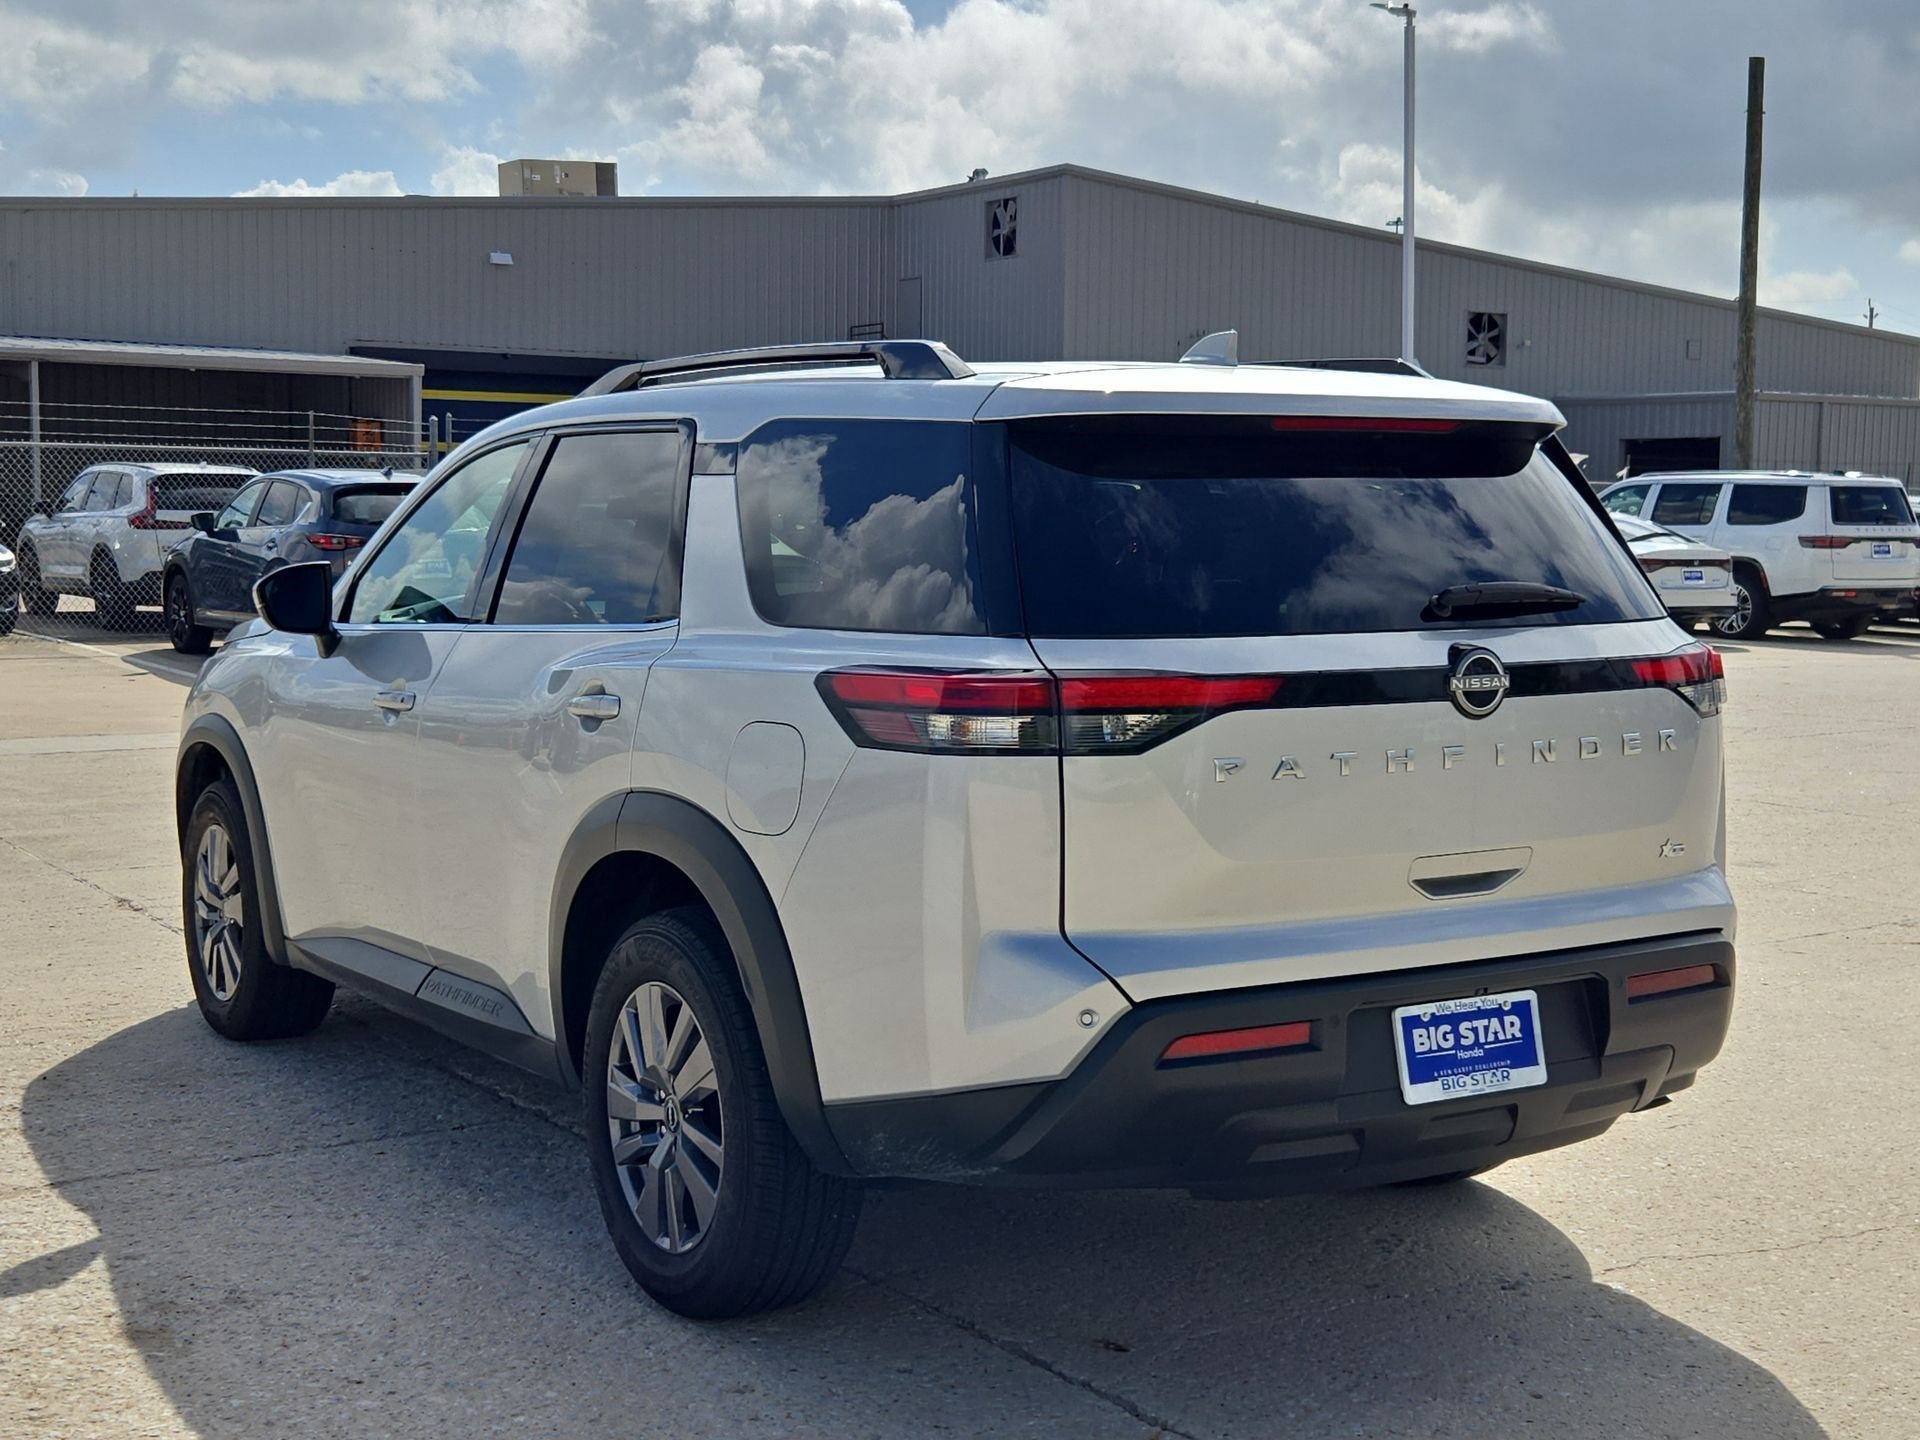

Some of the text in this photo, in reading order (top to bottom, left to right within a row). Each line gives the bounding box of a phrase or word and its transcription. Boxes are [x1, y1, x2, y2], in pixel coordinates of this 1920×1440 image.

[1452, 677, 1509, 689] NISSAN
[1213, 728, 1678, 782] PATHFINDER
[425, 979, 504, 1017] PATHFINDER
[1435, 997, 1498, 1013] We Hear You
[1412, 1014, 1522, 1053] BIG STAR
[1457, 1047, 1484, 1060] Honda
[1441, 1074, 1467, 1091] BIG
[1470, 1069, 1511, 1086] STAR
